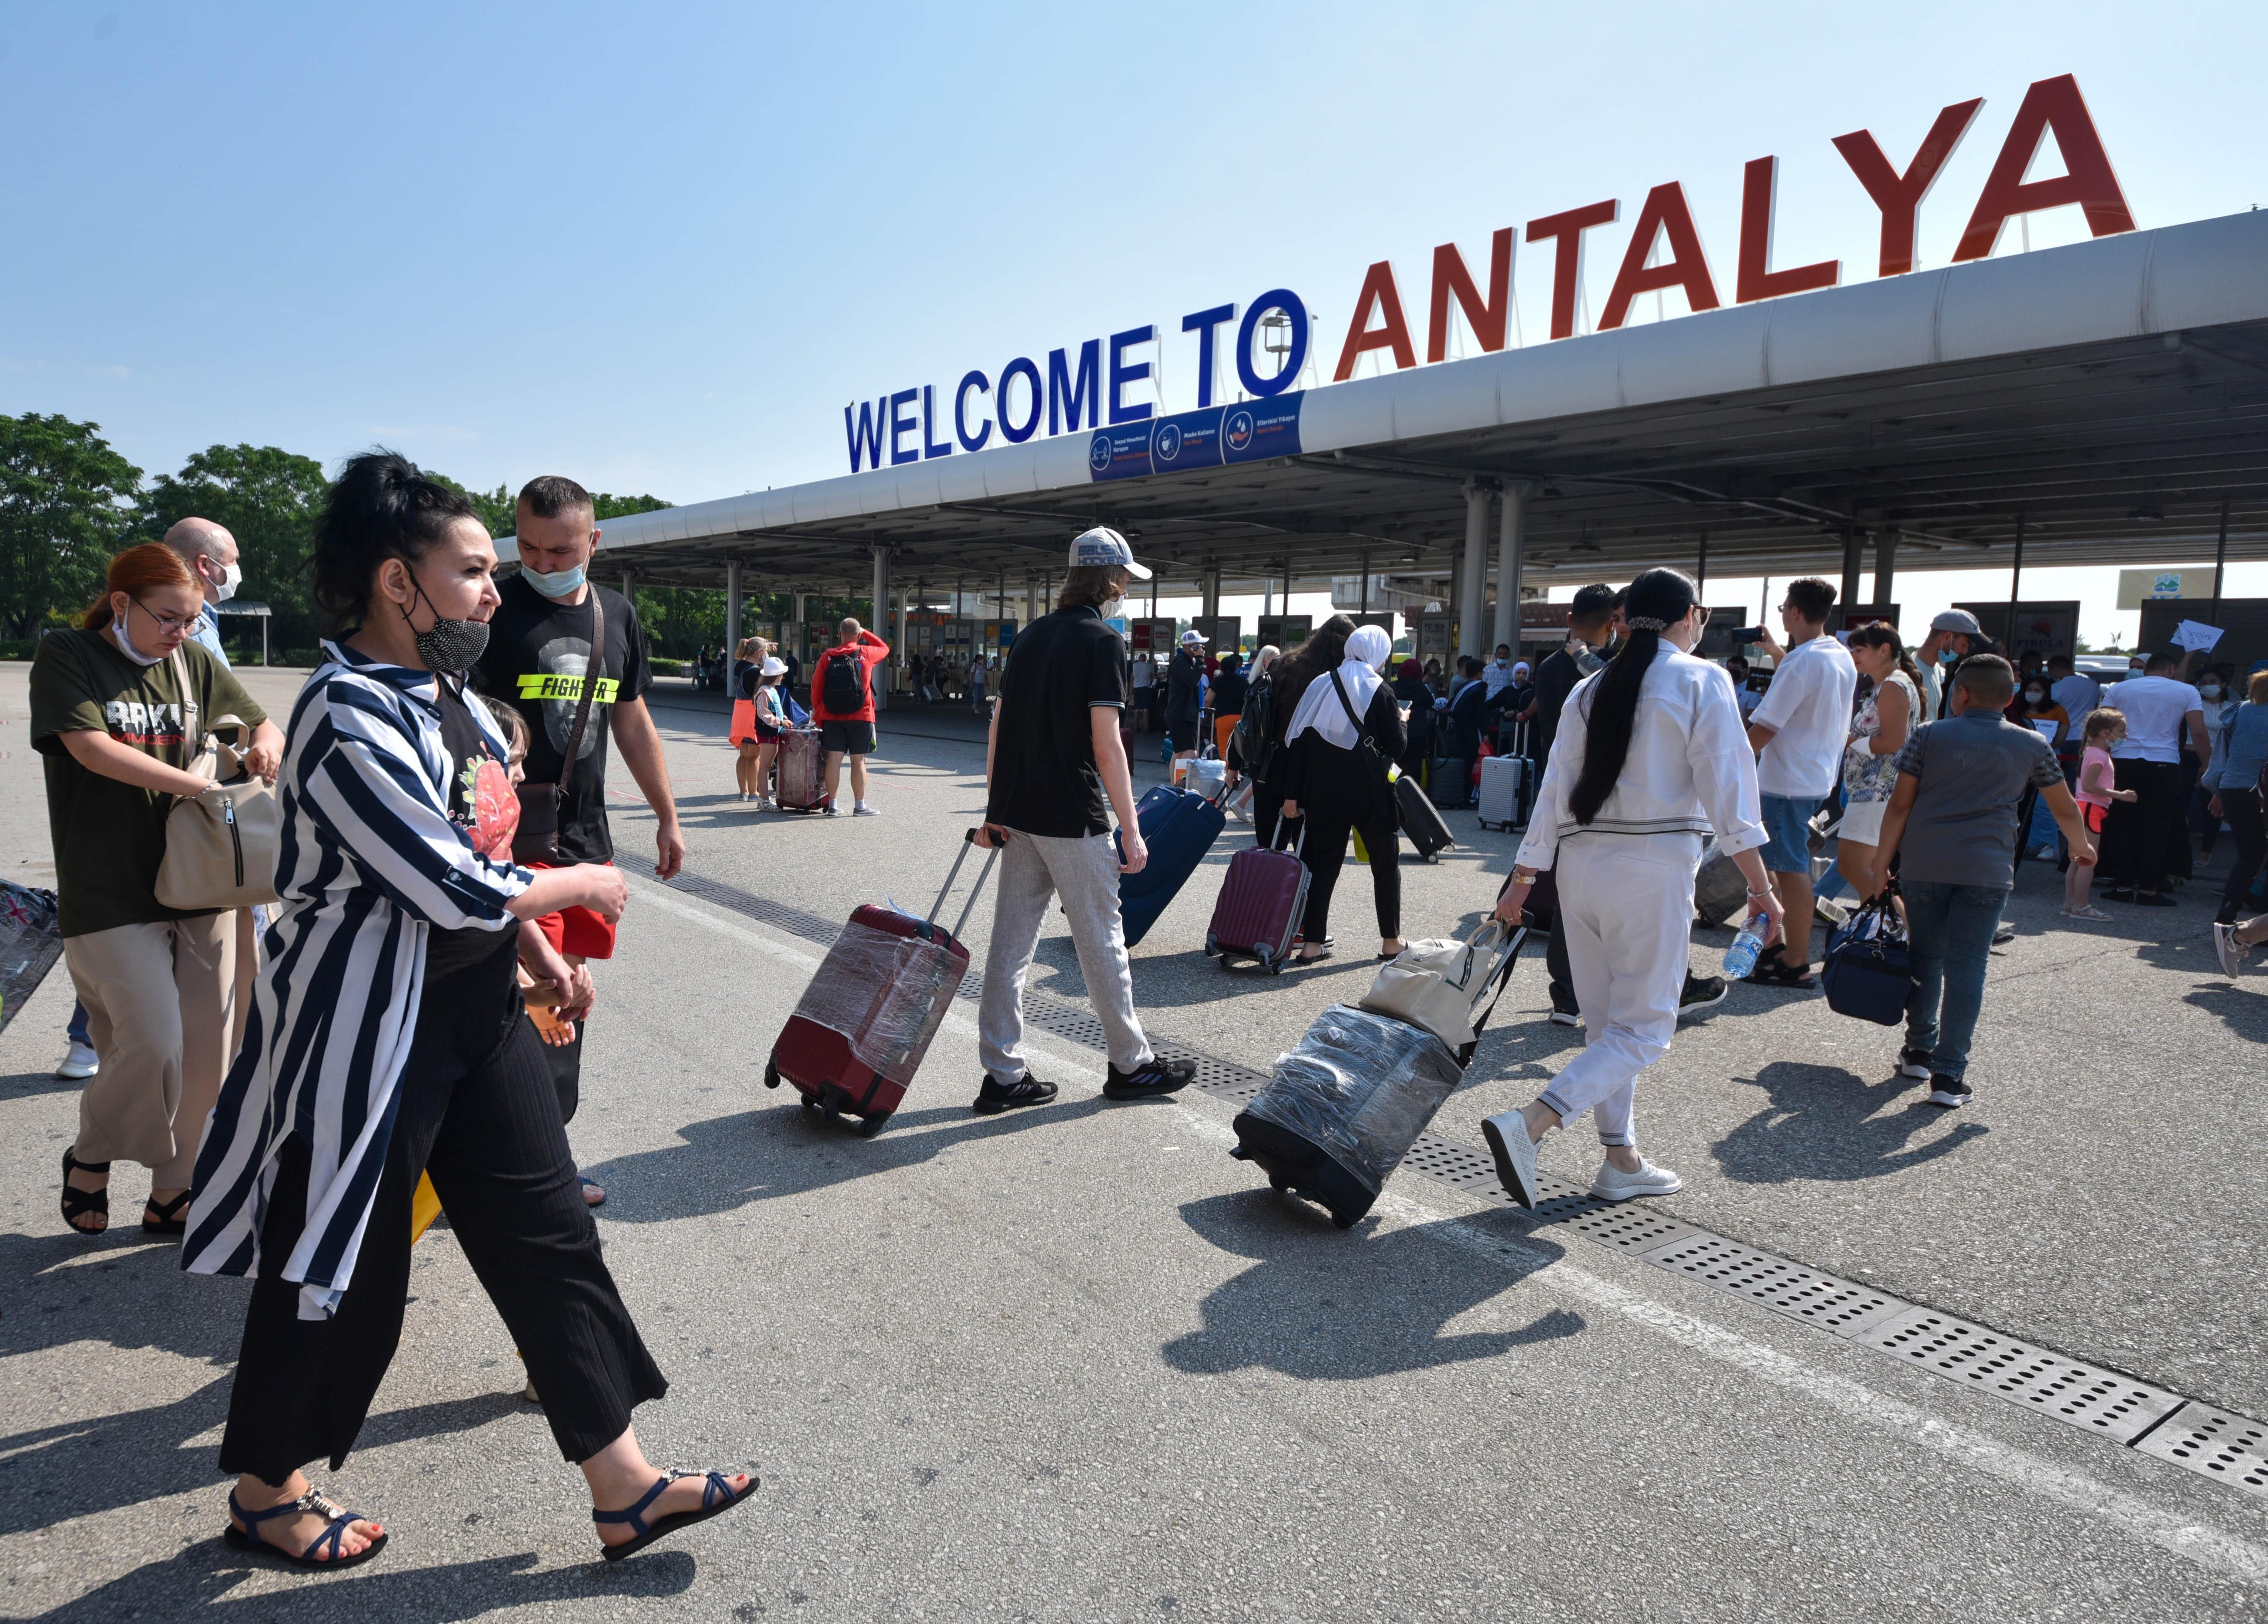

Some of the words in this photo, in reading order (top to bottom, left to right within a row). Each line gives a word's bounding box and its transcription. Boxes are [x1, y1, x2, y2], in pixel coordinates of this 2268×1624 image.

[844, 324, 1158, 473] WELCOME
[1182, 288, 1312, 408] TO
[1333, 72, 2138, 381] ANTALYA
[541, 677, 608, 699] FIGHR
